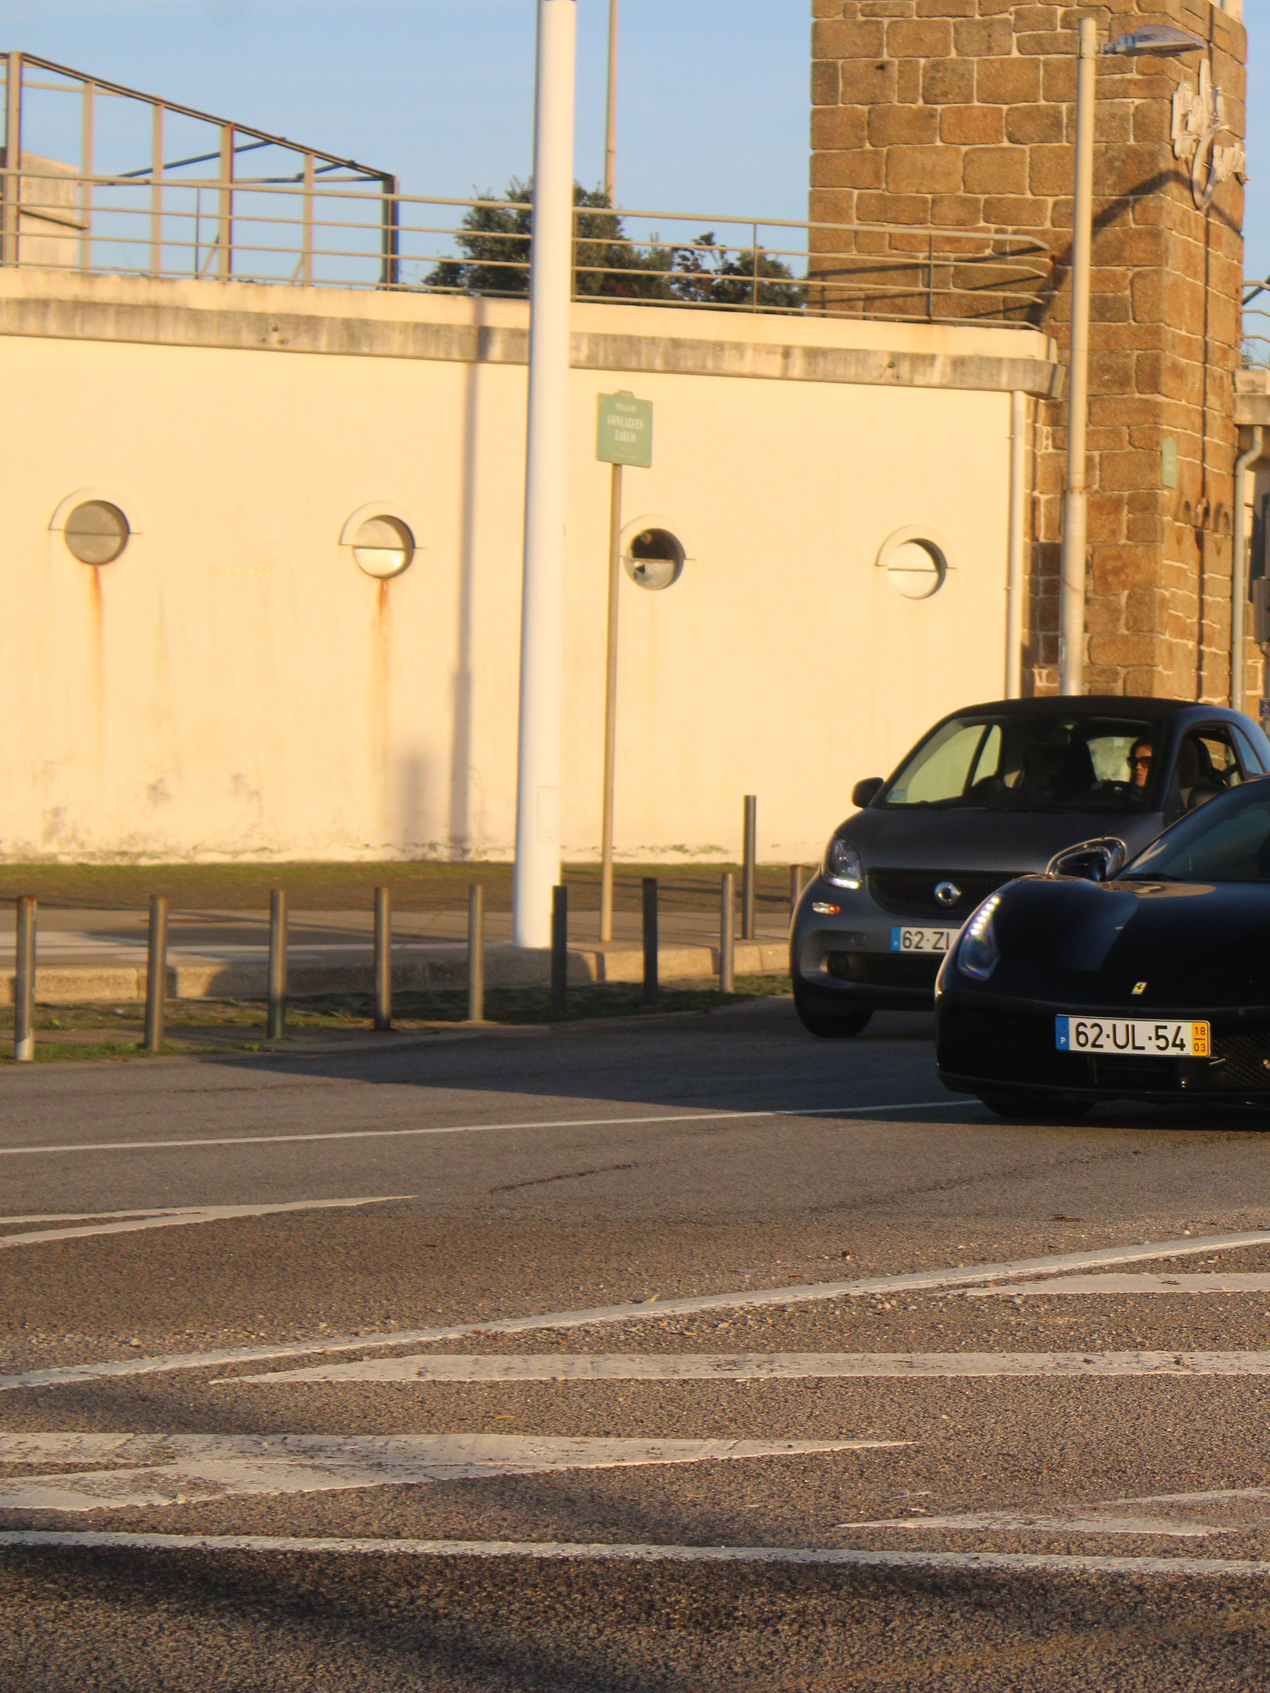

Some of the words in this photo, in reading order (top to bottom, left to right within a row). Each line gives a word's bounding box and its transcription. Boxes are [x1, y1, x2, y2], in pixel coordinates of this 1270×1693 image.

[606, 414, 644, 430] GONÇALVES
[614, 429, 636, 443] ZARCO
[1194, 1026, 1206, 1036] 18
[1193, 1042, 1206, 1053] 03
